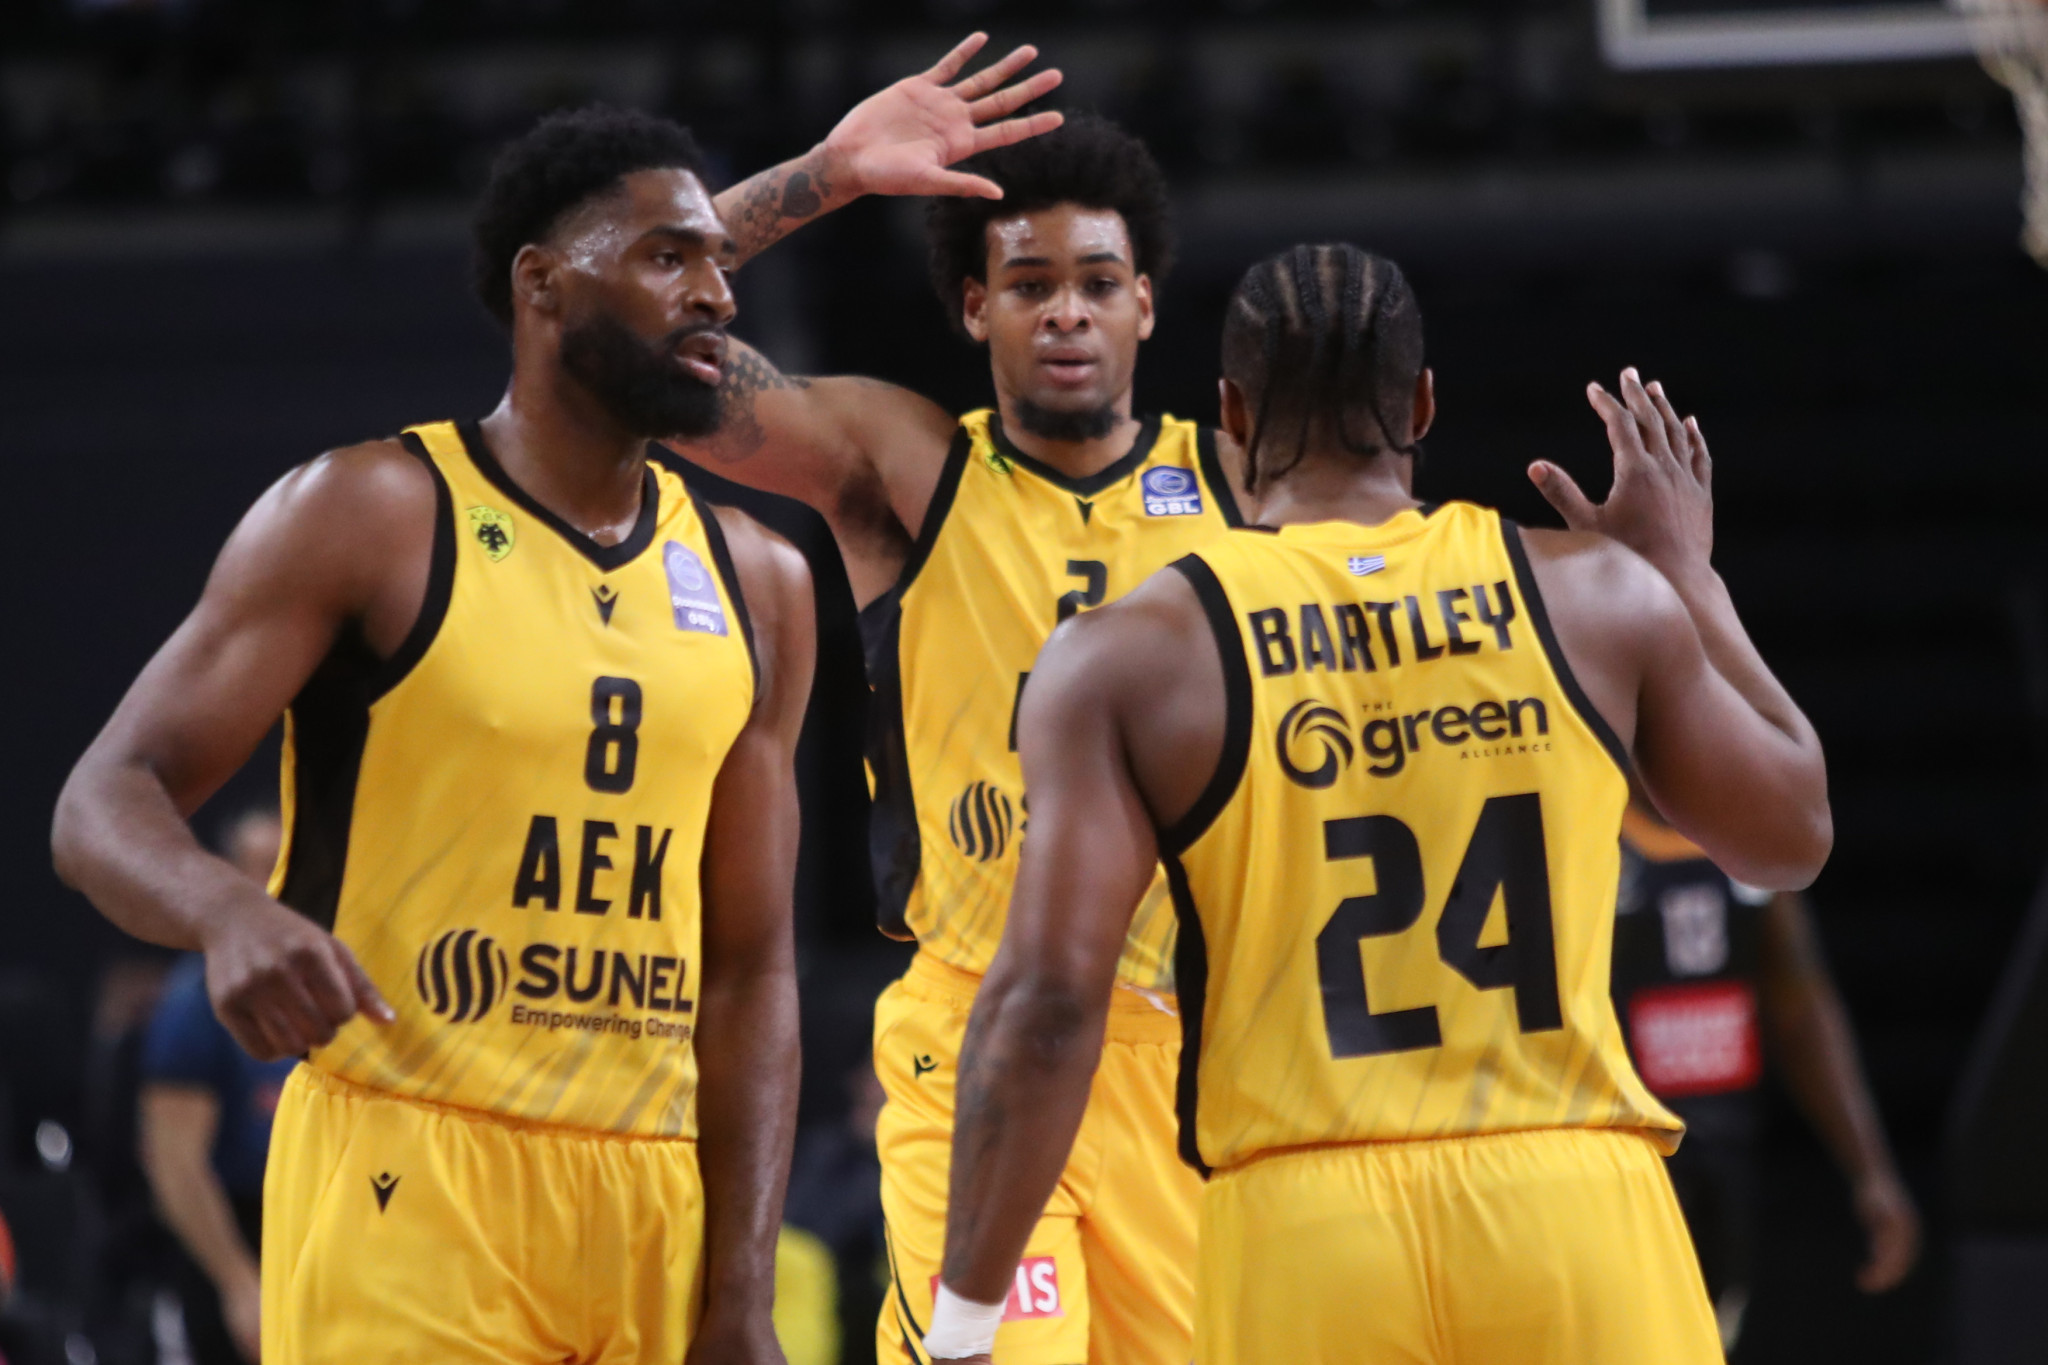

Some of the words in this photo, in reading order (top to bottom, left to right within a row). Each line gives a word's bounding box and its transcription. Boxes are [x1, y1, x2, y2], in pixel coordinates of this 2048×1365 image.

[1148, 501, 1200, 515] GBL
[1057, 559, 1107, 624] 2
[1247, 580, 1516, 679] BARTLEY
[584, 675, 643, 795] 8
[1361, 697, 1549, 778] green
[1362, 701, 1393, 713] THE
[1459, 742, 1552, 760] ALLIANCE
[511, 814, 673, 922] AEK
[1315, 792, 1564, 1061] 24
[515, 943, 693, 1013] SUNEL
[511, 1004, 642, 1040] Empowering
